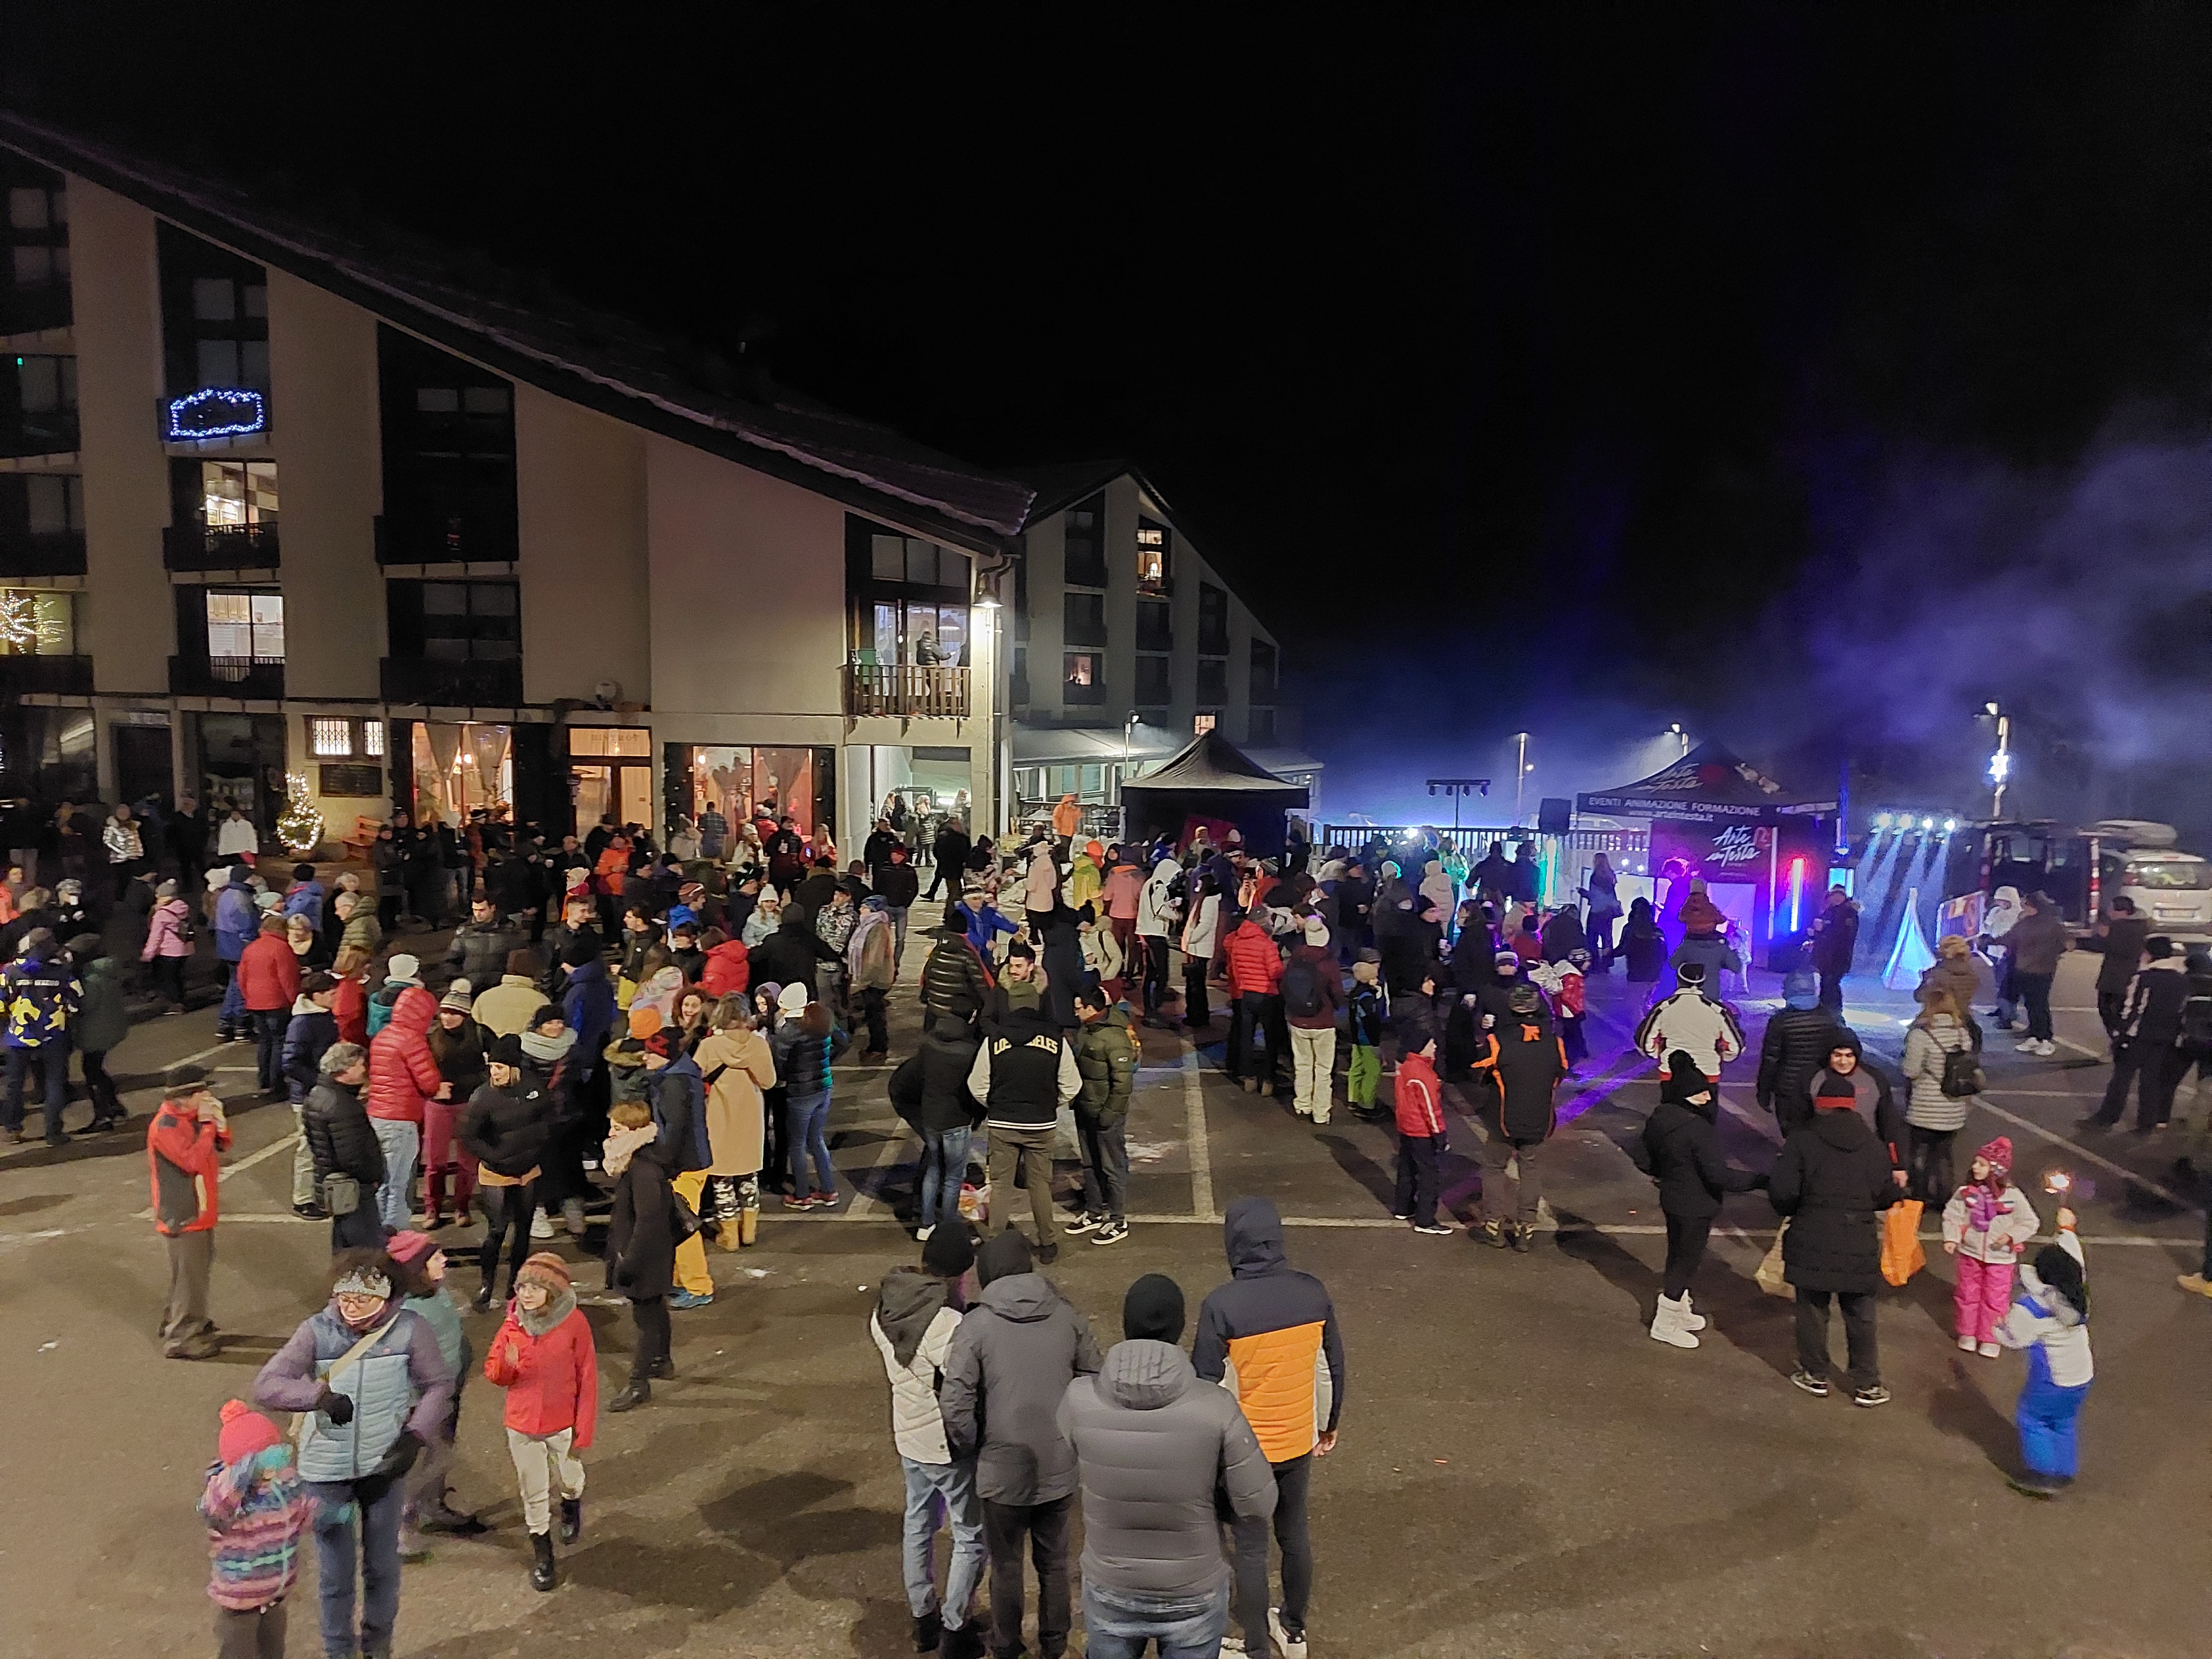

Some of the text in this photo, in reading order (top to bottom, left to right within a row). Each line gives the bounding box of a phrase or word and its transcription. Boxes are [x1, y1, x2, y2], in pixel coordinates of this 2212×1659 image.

[1588, 796, 1761, 816] EVENTI ANIMAZIONE FORMAZIONE
[1712, 825, 1752, 846] Arte
[1720, 841, 1761, 867] Testa
